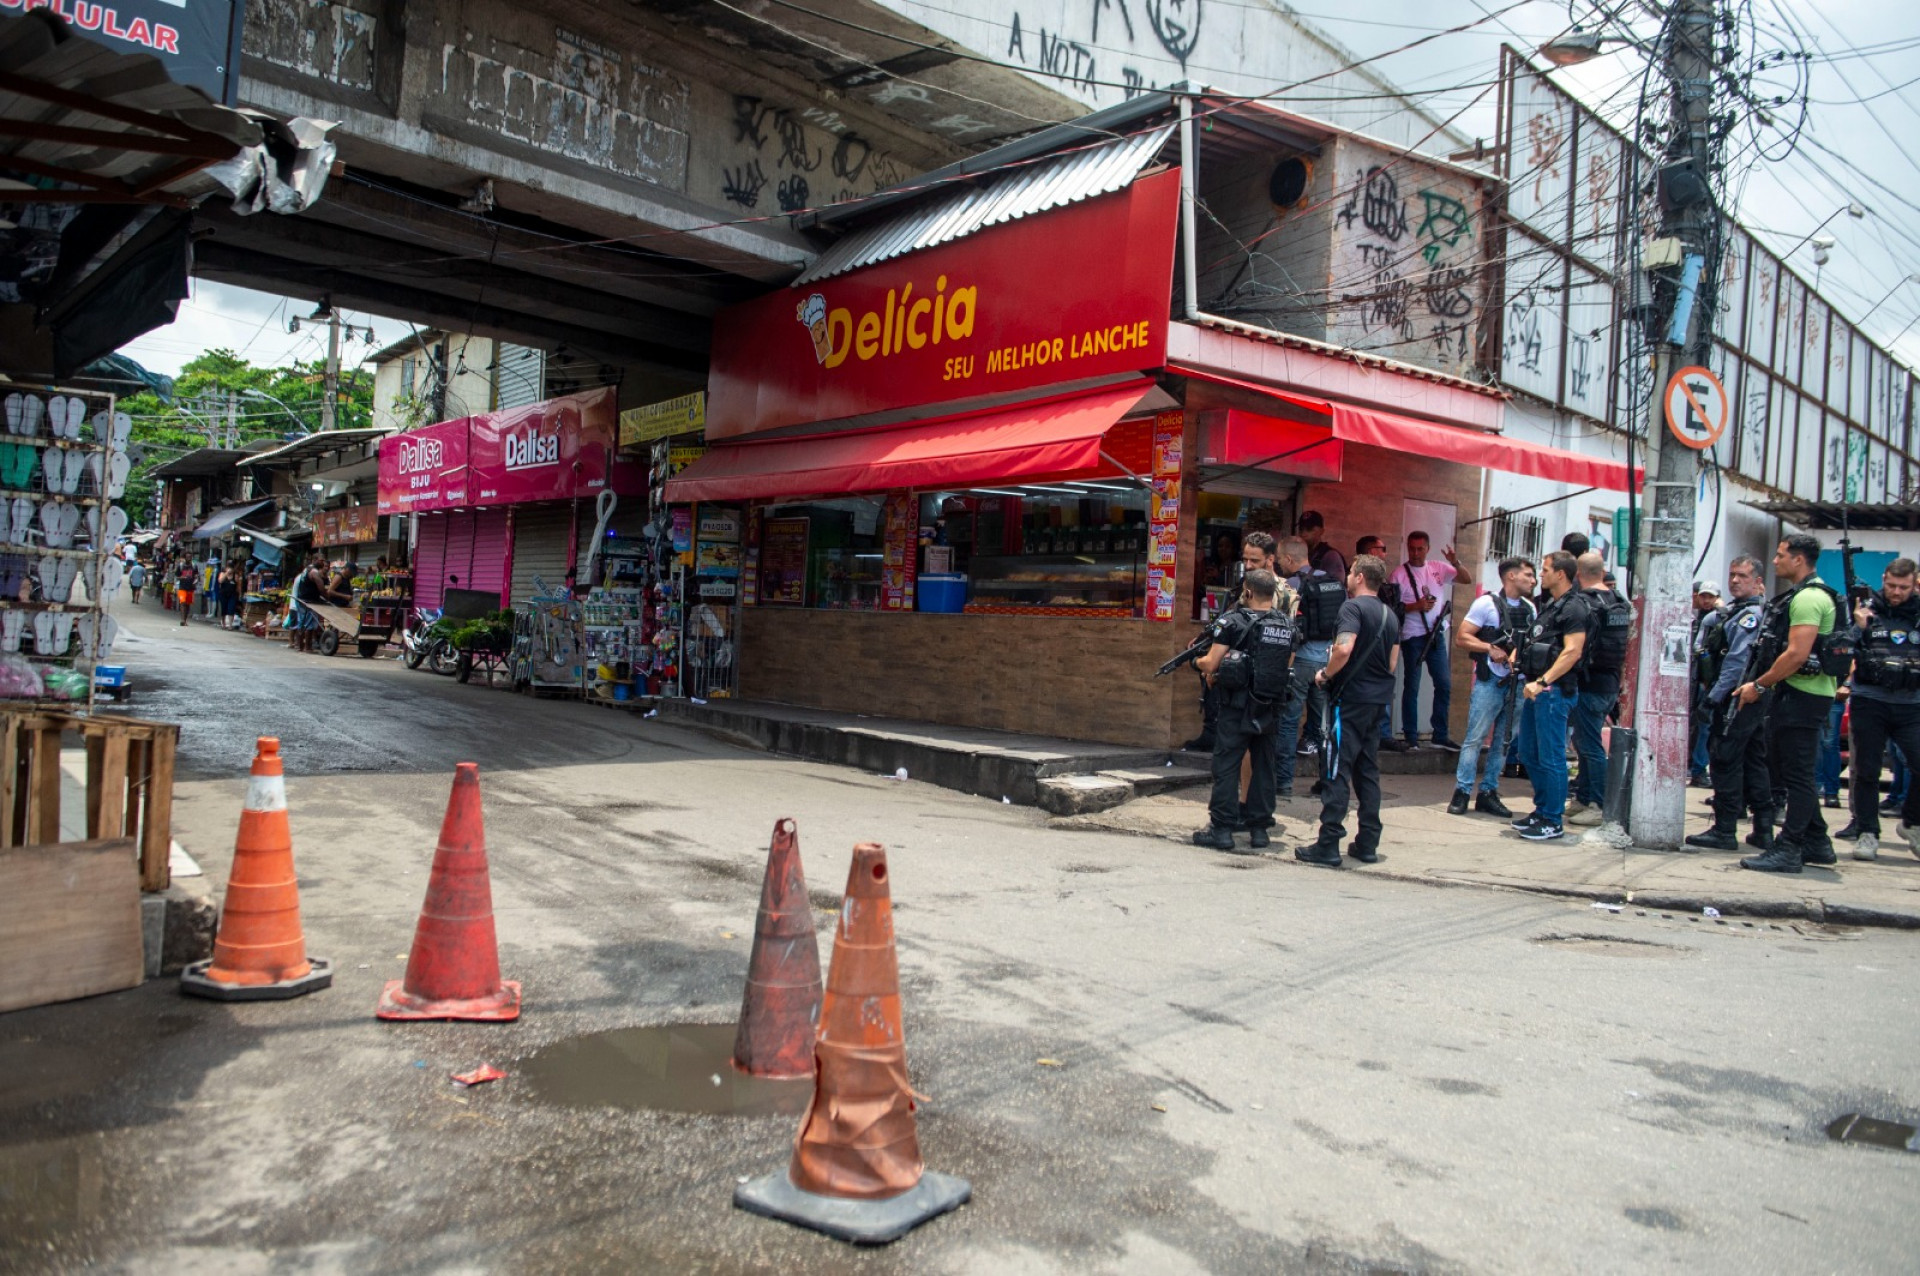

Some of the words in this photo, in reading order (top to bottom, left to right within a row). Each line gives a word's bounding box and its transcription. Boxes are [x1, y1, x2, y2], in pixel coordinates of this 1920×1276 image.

[1008, 11, 1025, 64] A
[1039, 28, 1097, 101] NOTA
[825, 274, 977, 369] Delícia
[943, 354, 974, 381] SEU
[986, 338, 1063, 374] MELHOR
[1070, 320, 1149, 359] LANCHE
[1685, 382, 1709, 432] E
[399, 437, 443, 475] Dalisa
[505, 428, 559, 467] Dalisa
[411, 474, 430, 489] BIJU
